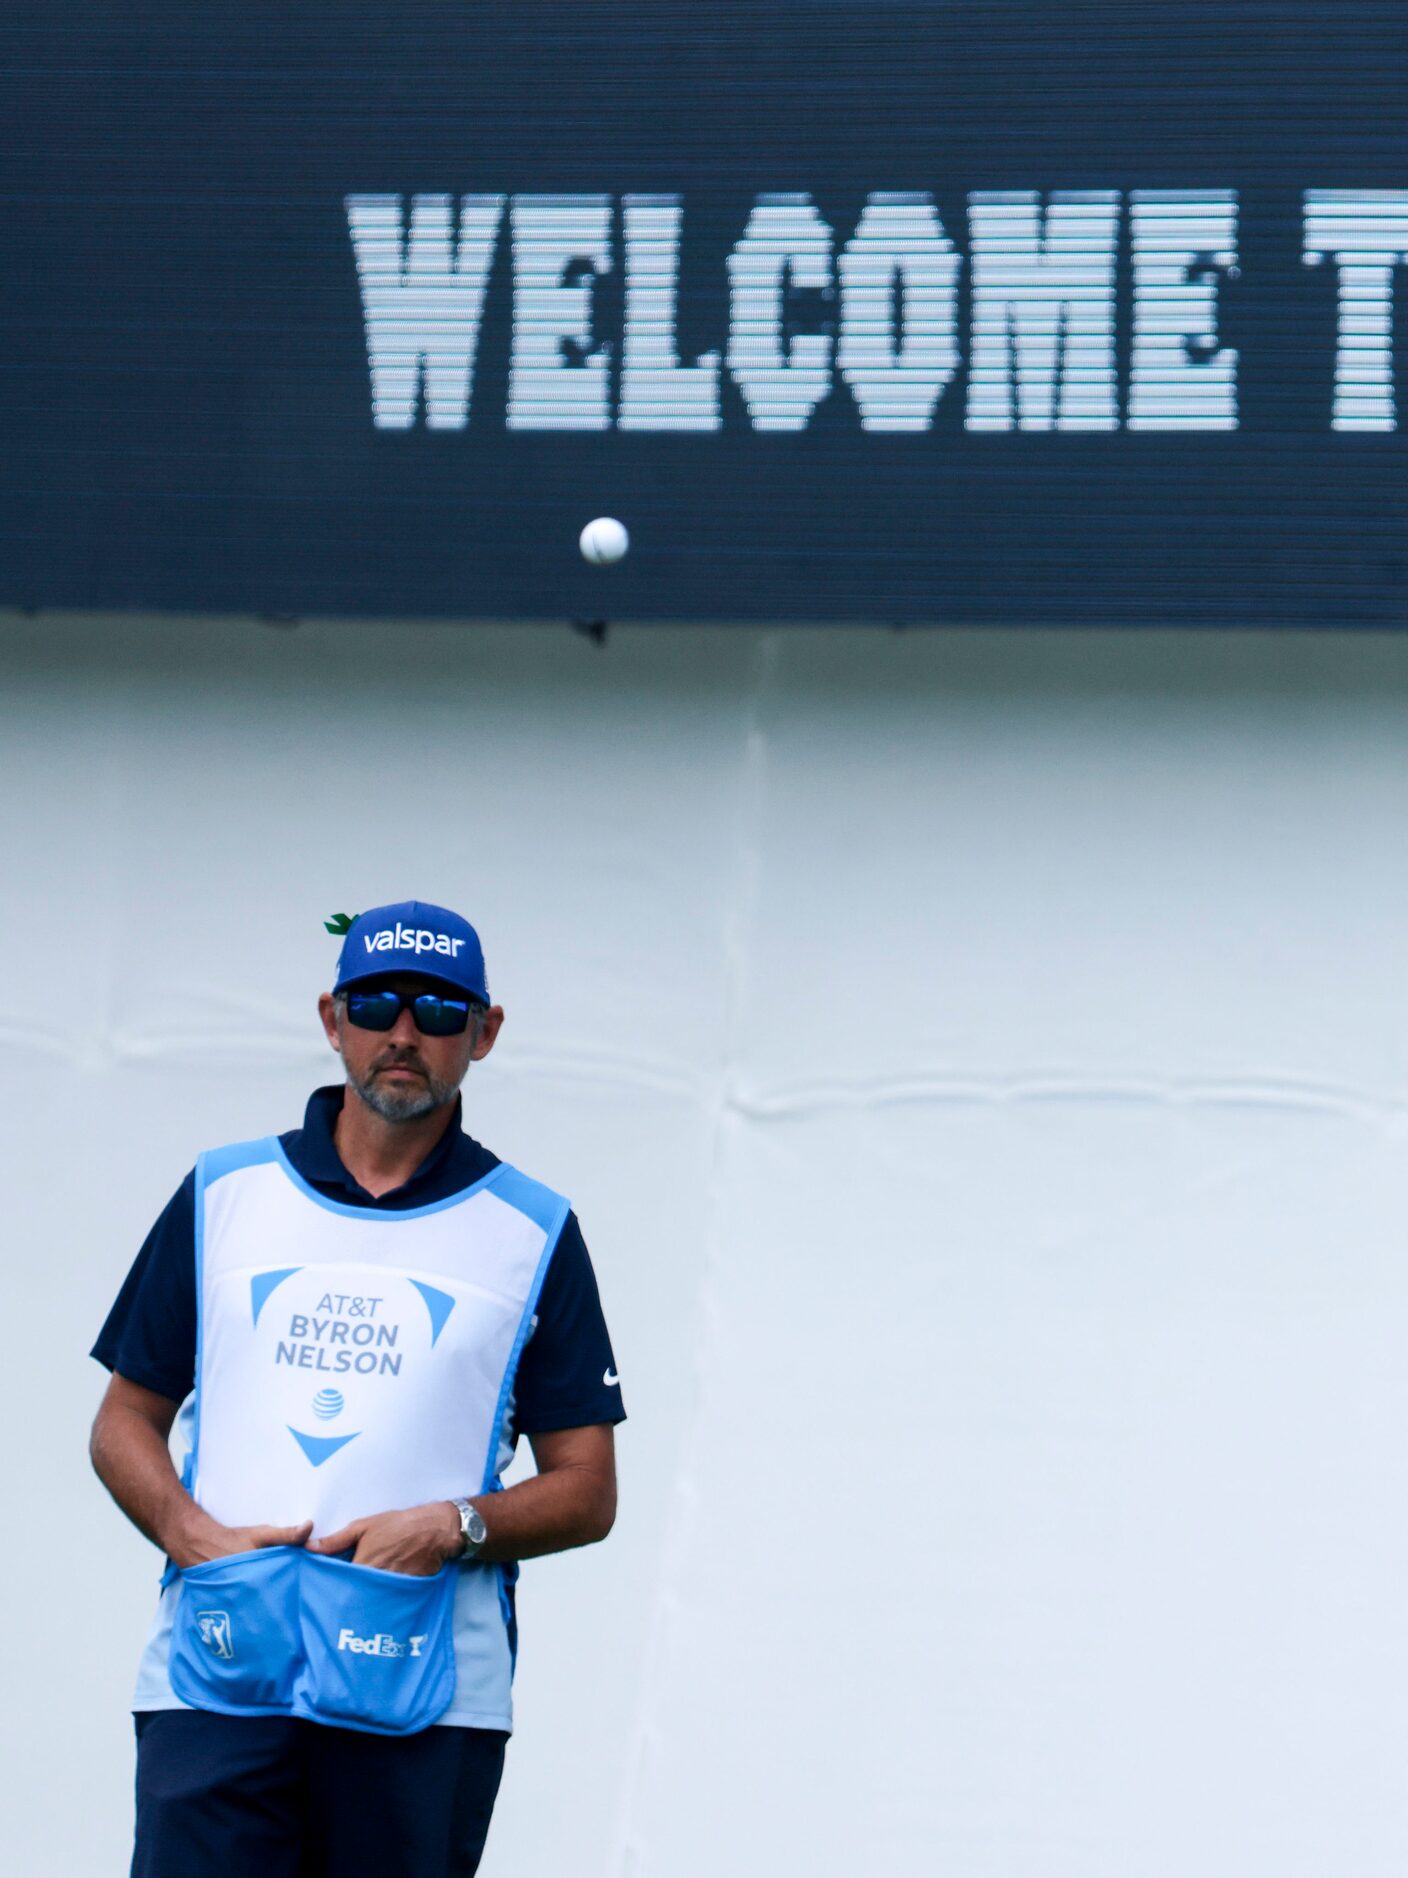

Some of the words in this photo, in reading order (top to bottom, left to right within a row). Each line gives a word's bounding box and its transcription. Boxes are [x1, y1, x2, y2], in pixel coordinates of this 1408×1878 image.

[344, 190, 1239, 431] WELCOME
[363, 922, 467, 958] valspar
[315, 1293, 384, 1318] AT&T
[289, 1314, 399, 1347] BYRON
[275, 1341, 403, 1376] NELSON
